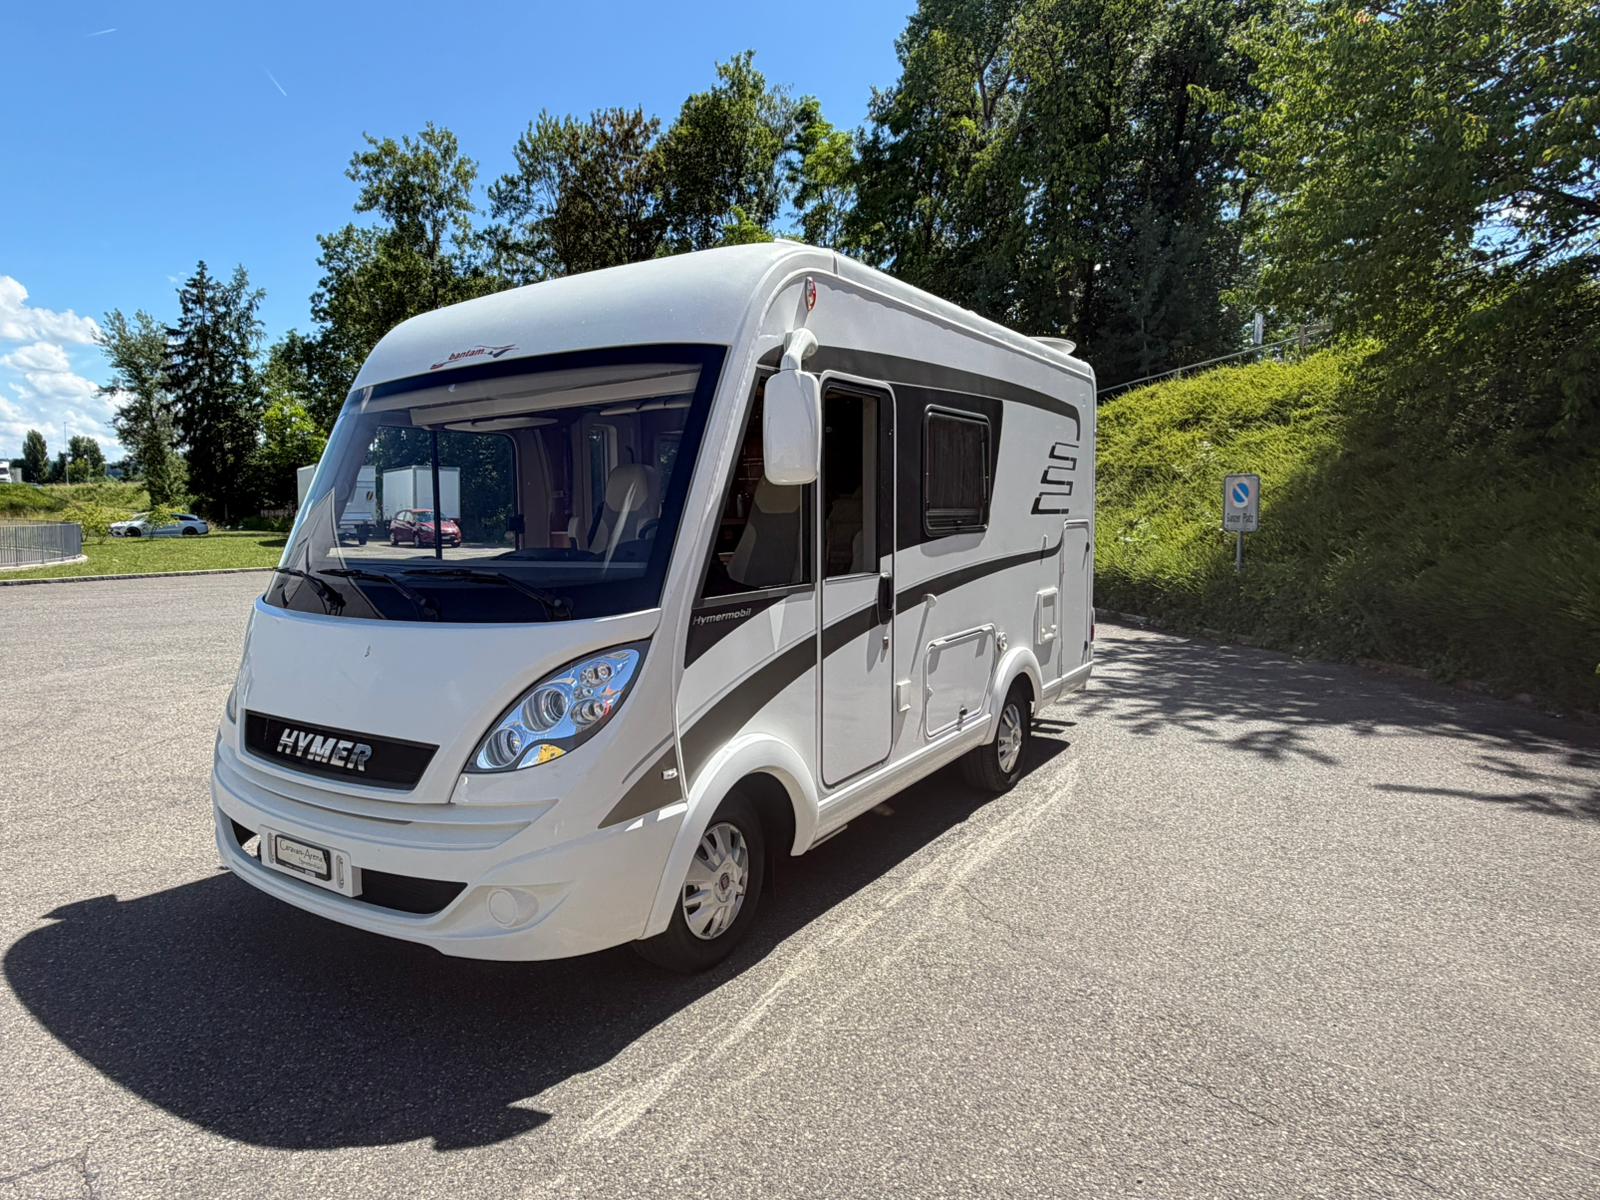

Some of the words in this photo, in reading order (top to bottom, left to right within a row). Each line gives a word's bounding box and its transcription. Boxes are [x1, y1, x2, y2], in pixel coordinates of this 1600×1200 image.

[449, 348, 485, 361] bantam
[692, 607, 752, 626] Hymermobil
[276, 727, 373, 772] HYMER
